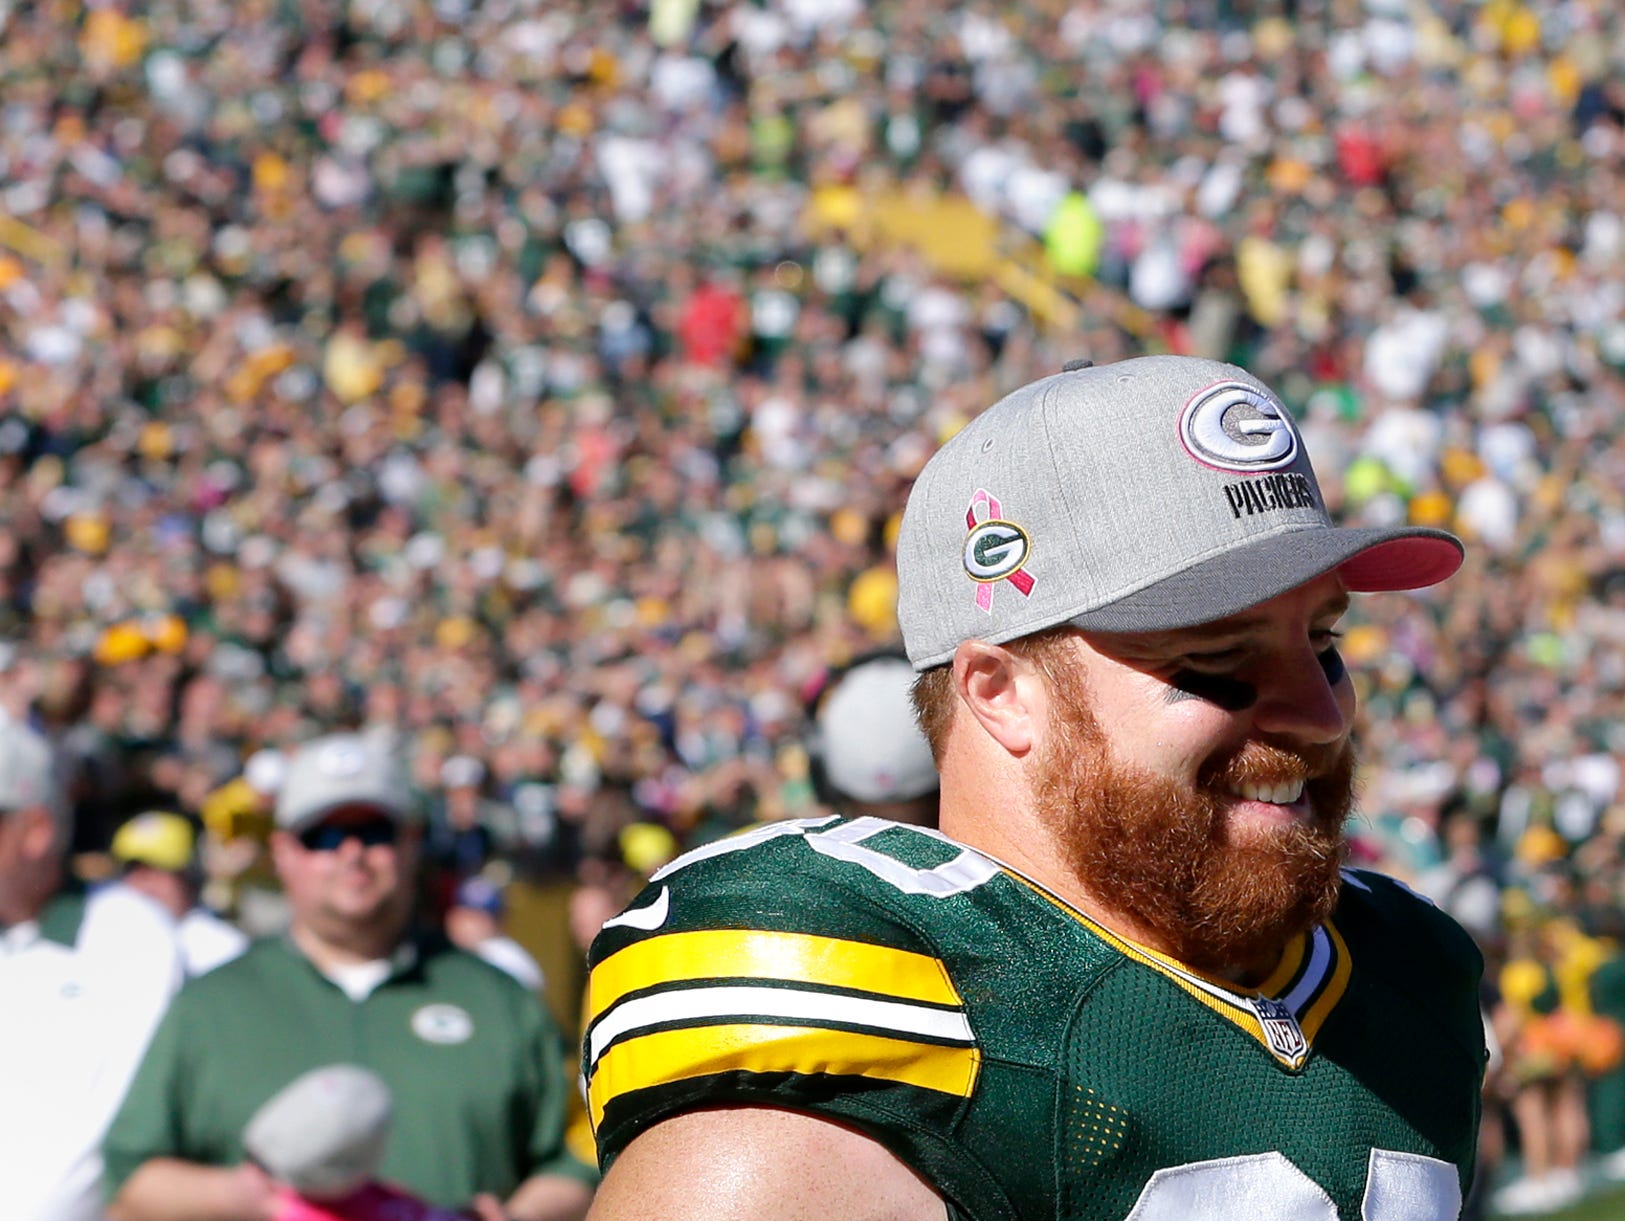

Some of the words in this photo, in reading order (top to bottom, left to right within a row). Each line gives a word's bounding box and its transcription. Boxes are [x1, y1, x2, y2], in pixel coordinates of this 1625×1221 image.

[1192, 388, 1291, 461] G
[965, 525, 1024, 576] G
[1267, 1020, 1302, 1053] NFL
